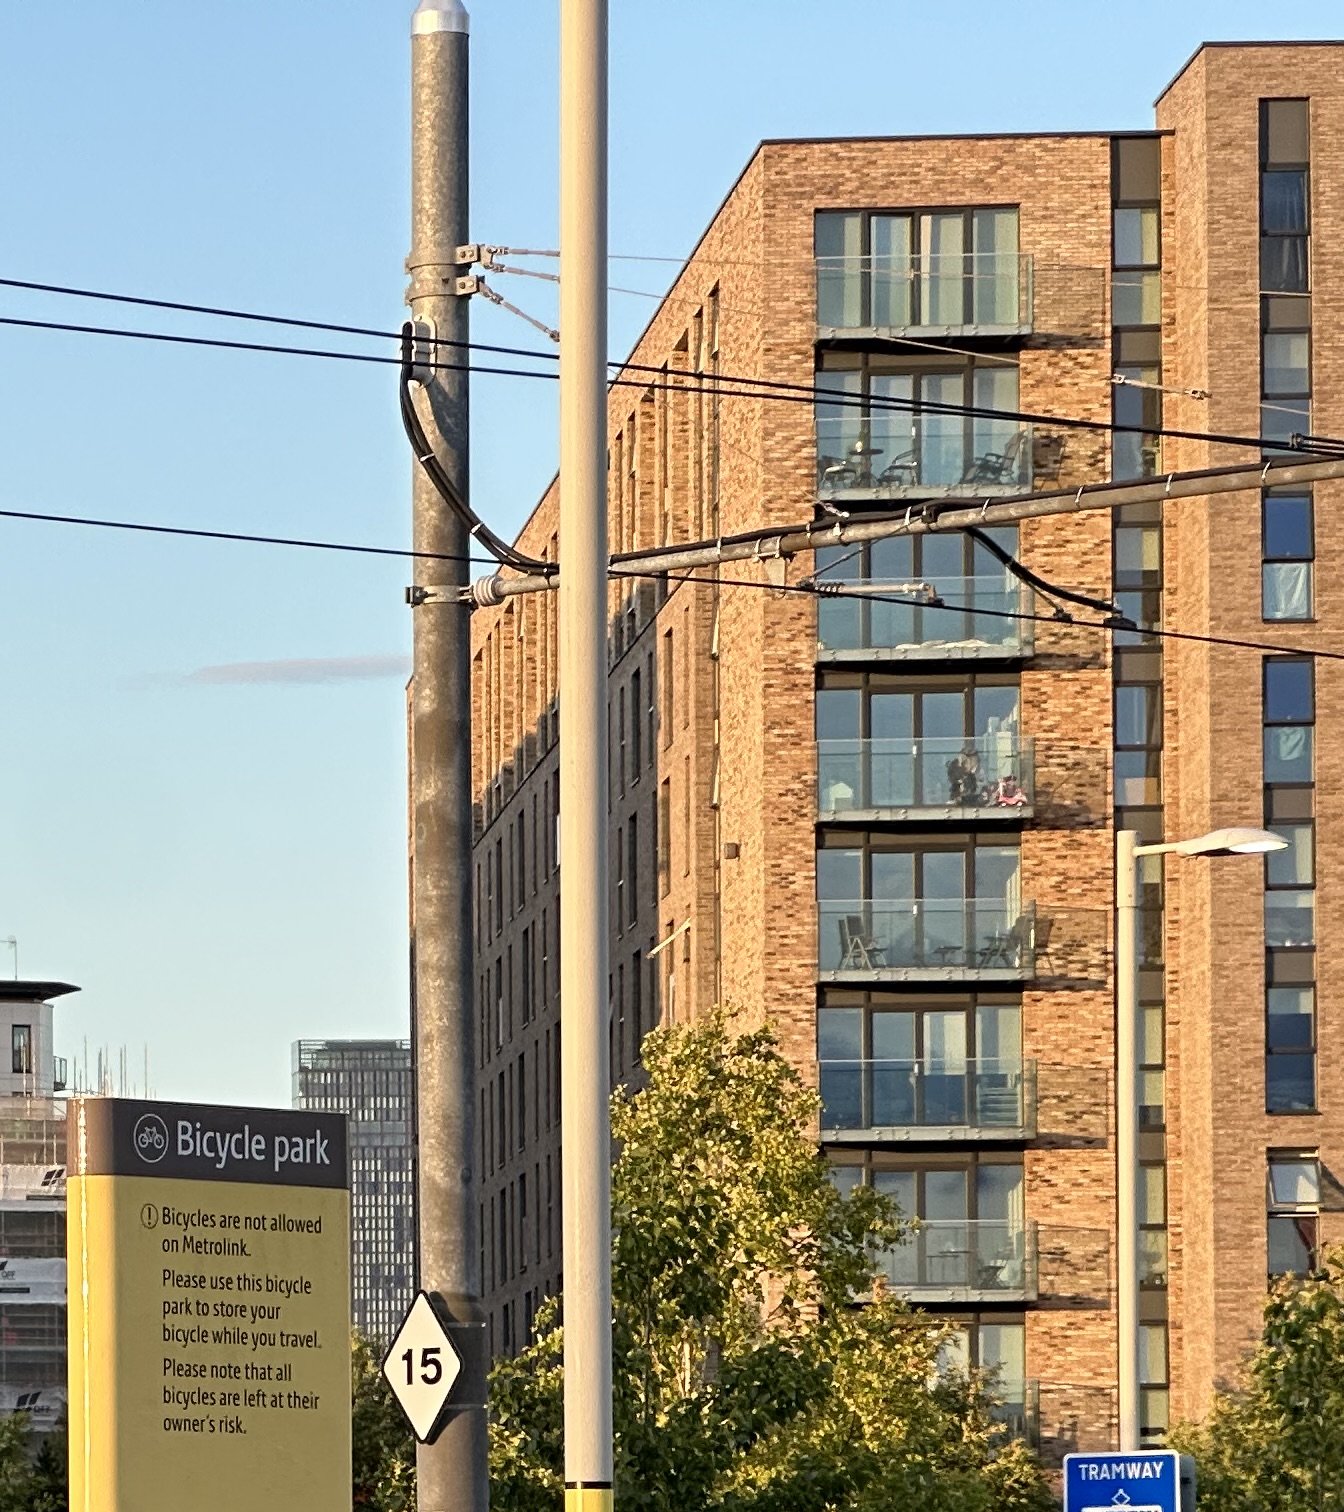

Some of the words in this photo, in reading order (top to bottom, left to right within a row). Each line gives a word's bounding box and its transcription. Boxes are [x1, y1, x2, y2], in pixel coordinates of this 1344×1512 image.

[177, 1120, 266, 1169] Bicycle
[274, 1129, 331, 1172] park
[162, 1206, 216, 1232] Bicycles
[219, 1215, 241, 1230] are
[244, 1213, 267, 1231] not
[270, 1213, 322, 1234] allowed
[162, 1238, 179, 1253] on
[182, 1235, 251, 1257] Metrolink.
[162, 1269, 206, 1289] Please
[210, 1275, 233, 1291] use
[236, 1272, 262, 1292] this
[265, 1274, 312, 1298] bicycle
[162, 1297, 193, 1320] park
[195, 1300, 210, 1317] to
[213, 1300, 247, 1318] store
[250, 1304, 281, 1324] your
[162, 1323, 209, 1348] bicycle
[212, 1326, 249, 1346] while
[251, 1331, 276, 1351] you
[280, 1330, 322, 1349] travel.
[163, 1358, 207, 1378] Please
[210, 1363, 241, 1380] note
[244, 1361, 273, 1381] that
[275, 1362, 292, 1382] all
[402, 1347, 443, 1386] 15
[163, 1385, 216, 1410] bicycles
[219, 1392, 241, 1407] are
[244, 1389, 267, 1408] left
[270, 1392, 284, 1409] at
[287, 1391, 320, 1410] their
[163, 1414, 216, 1433] owner's
[219, 1415, 247, 1434] risk.
[1078, 1461, 1164, 1481] TRAMWAY
